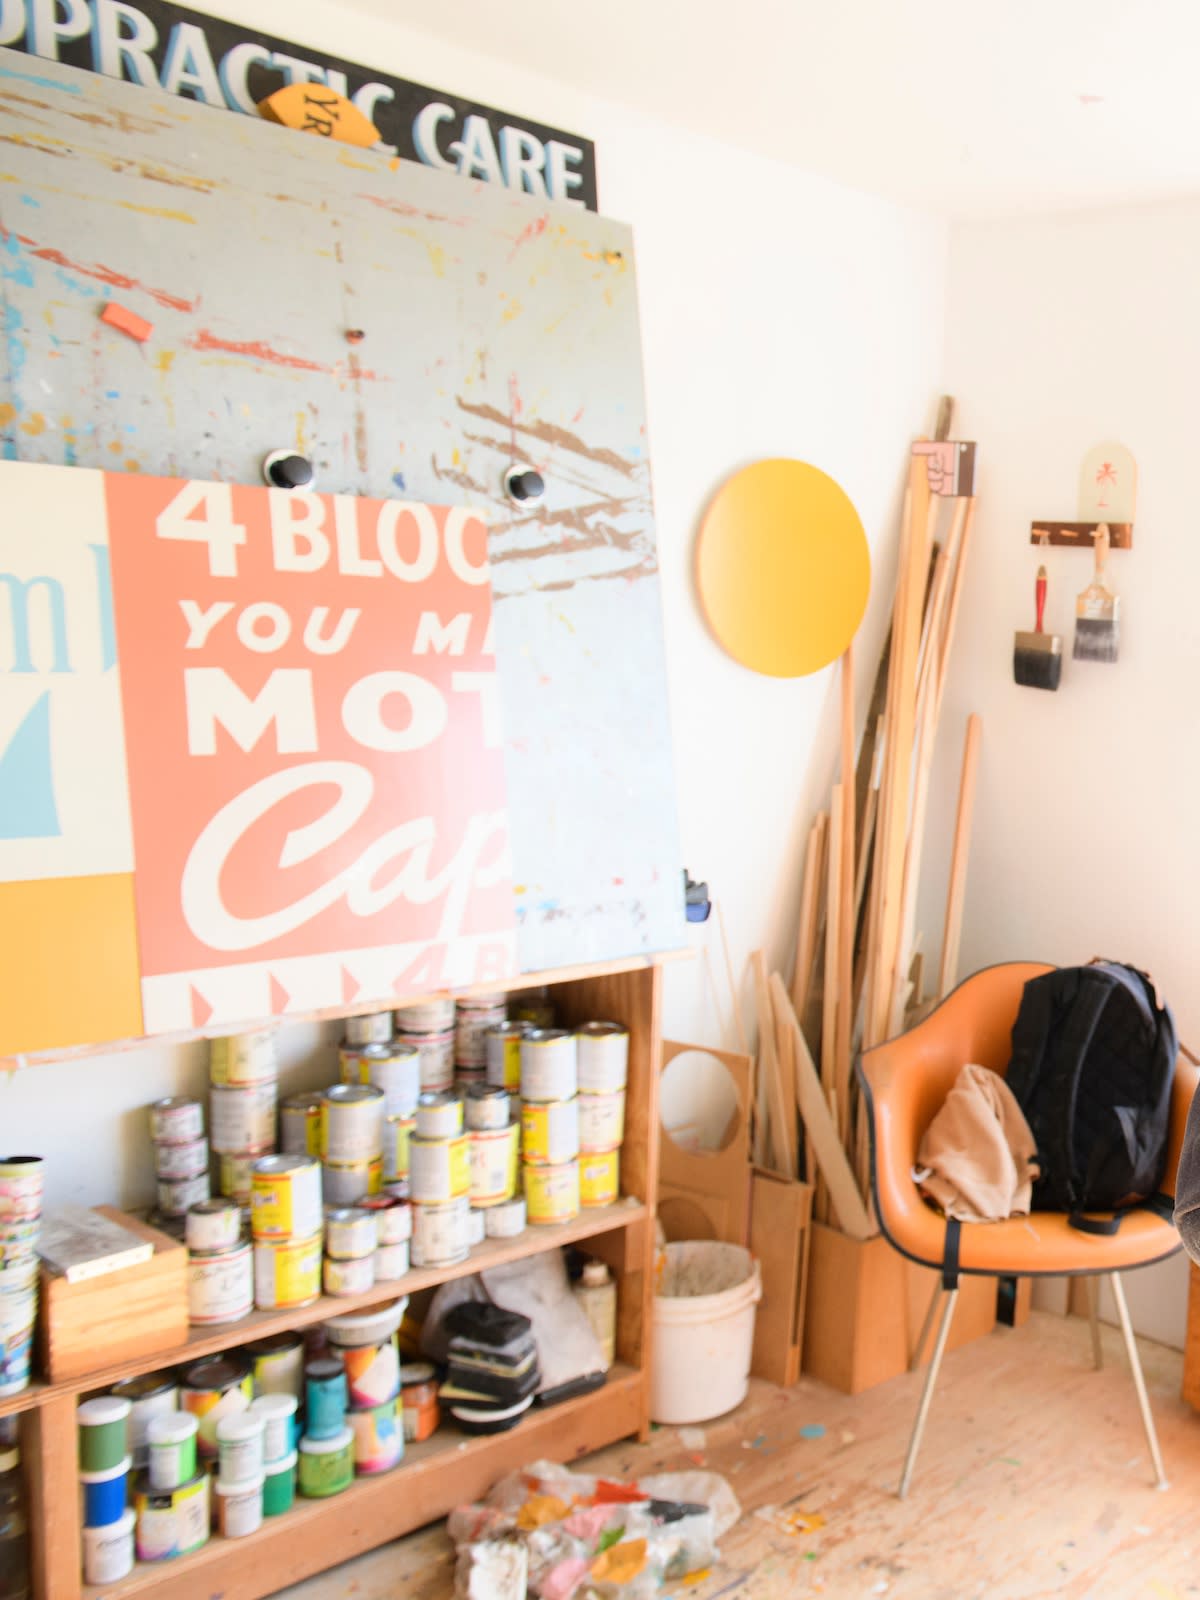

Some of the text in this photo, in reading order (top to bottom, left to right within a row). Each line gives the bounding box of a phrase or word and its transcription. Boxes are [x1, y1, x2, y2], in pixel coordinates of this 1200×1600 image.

[412, 102, 587, 209] CARE
[156, 480, 247, 578] 4
[178, 600, 496, 657] YOU M
[184, 667, 503, 757] MOT
[181, 760, 511, 960] Cap
